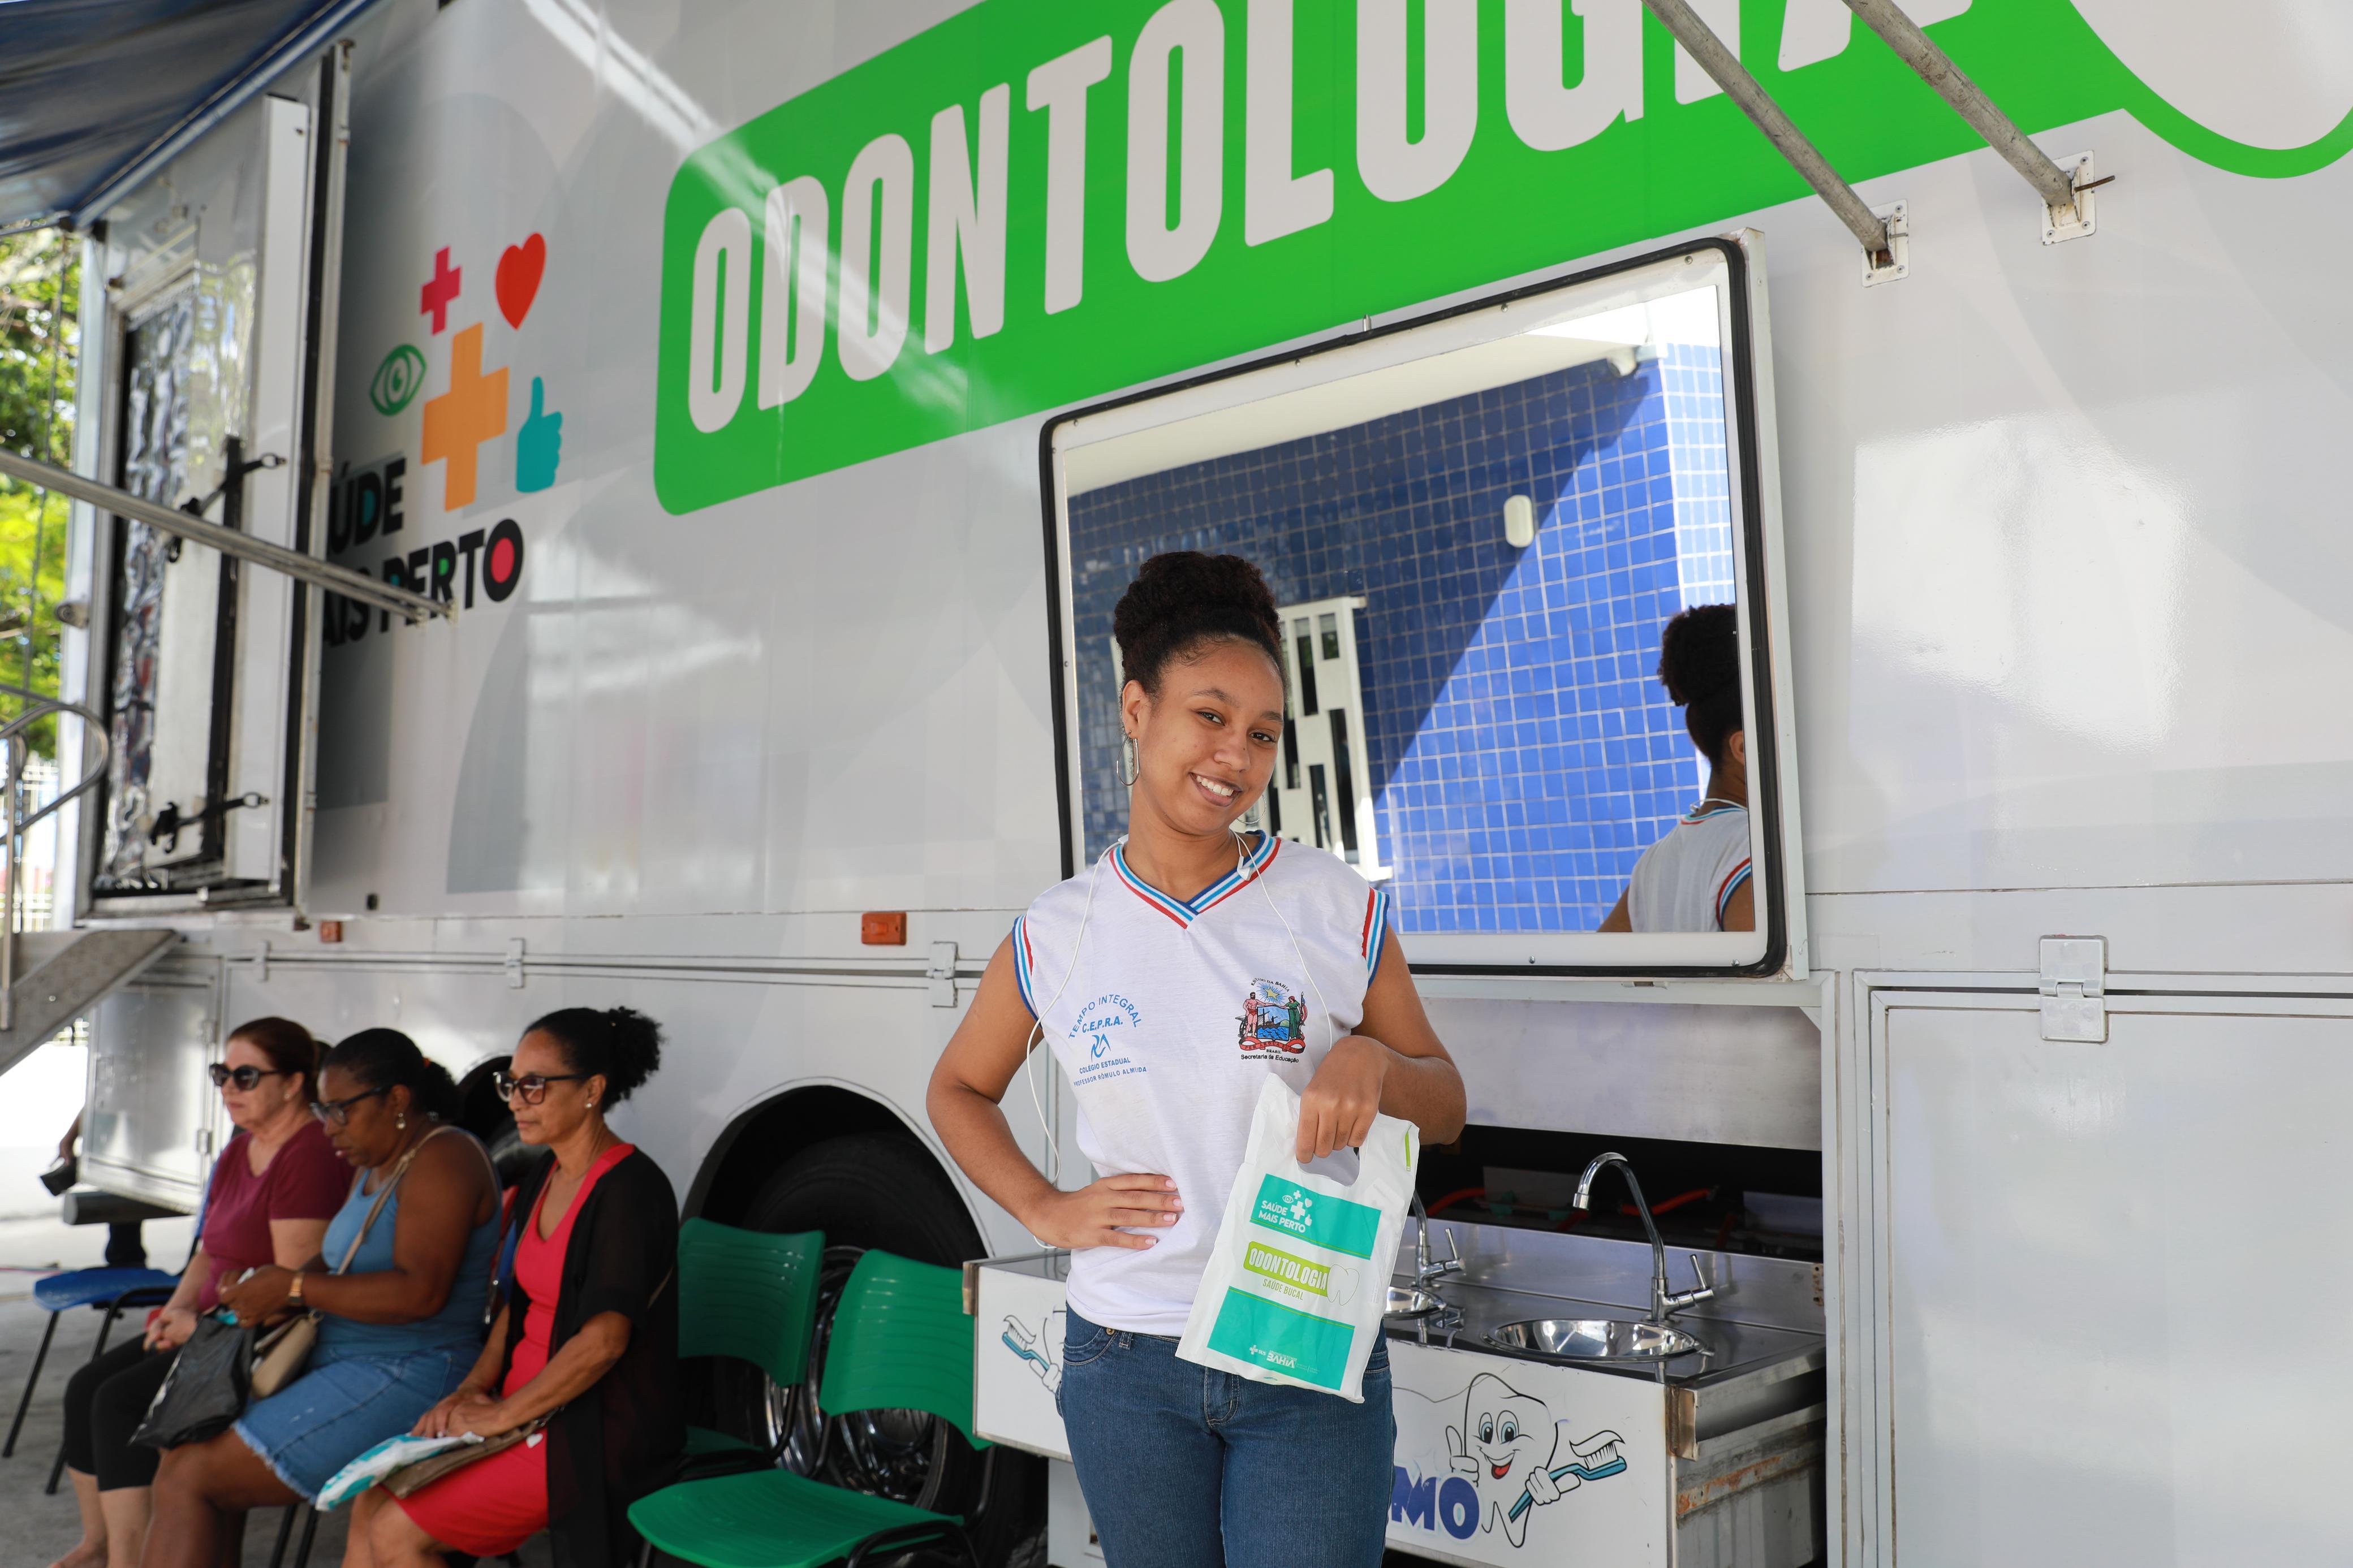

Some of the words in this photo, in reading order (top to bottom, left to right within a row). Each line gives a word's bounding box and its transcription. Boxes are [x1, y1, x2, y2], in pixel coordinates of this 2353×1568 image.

[327, 457, 406, 554] ÚDE
[1275, 981, 1290, 992] BAHIA
[1068, 1001, 1095, 1039] TEMPO
[1098, 994, 1141, 1027] INTEGRAL
[1082, 1016, 1123, 1033] C.E.P.R.A.
[1079, 1063, 1100, 1074] COLÉGIO
[1101, 1057, 1131, 1068] ESTADUAL
[1275, 1055, 1299, 1063] Educação
[1074, 1075, 1097, 1087] PROFESSOR
[1122, 1066, 1147, 1075] ALMEIDA
[1261, 1200, 1288, 1216] SAÚDE
[1259, 1210, 1278, 1223] MAIS
[1279, 1216, 1305, 1233] PERTO
[1248, 1247, 1328, 1291] ODONTOLOGIA
[1262, 1278, 1283, 1293] SAÚDE
[1283, 1285, 1303, 1301] BUCAL
[1391, 1465, 1480, 1540] MO
